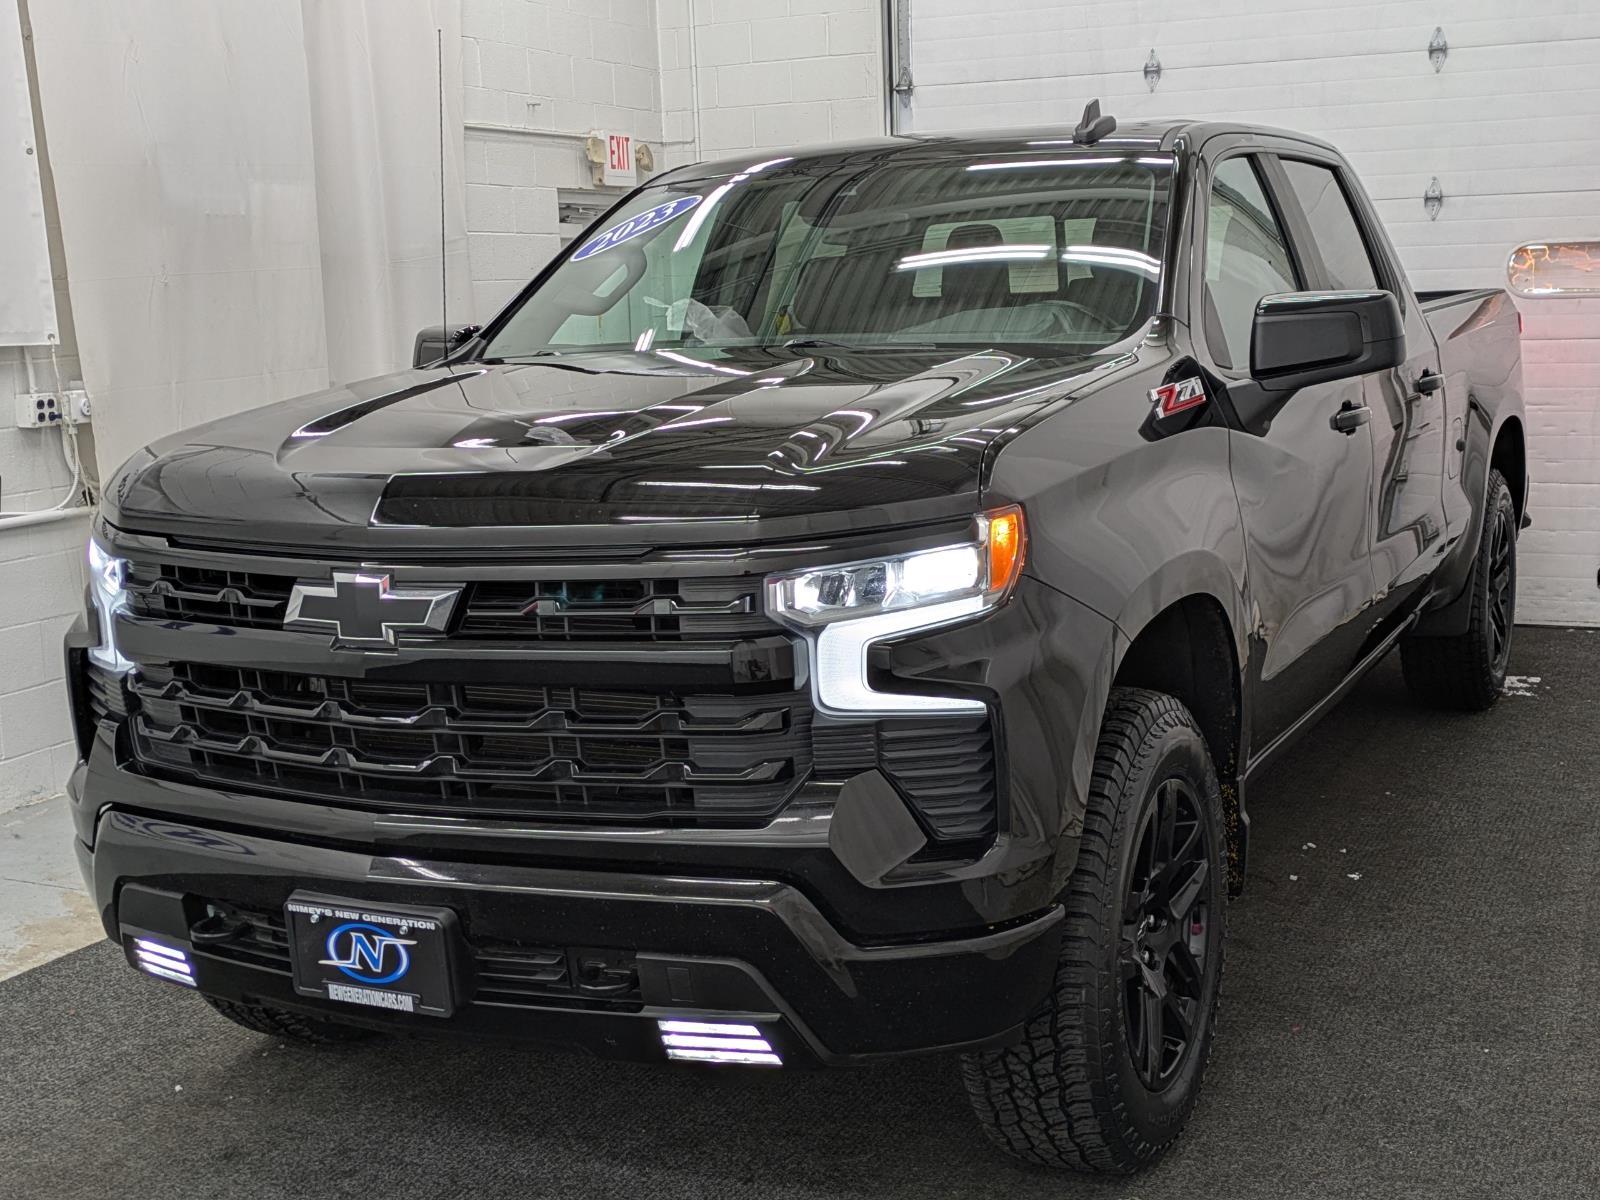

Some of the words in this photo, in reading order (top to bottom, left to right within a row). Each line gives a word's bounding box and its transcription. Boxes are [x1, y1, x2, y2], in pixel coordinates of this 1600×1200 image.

[609, 135, 630, 170] EXIT
[588, 202, 678, 255] 2023
[1147, 376, 1206, 419] Z71
[287, 904, 333, 917] NIMEY'S
[335, 911, 360, 920] NEW
[362, 914, 436, 930] GENERATION
